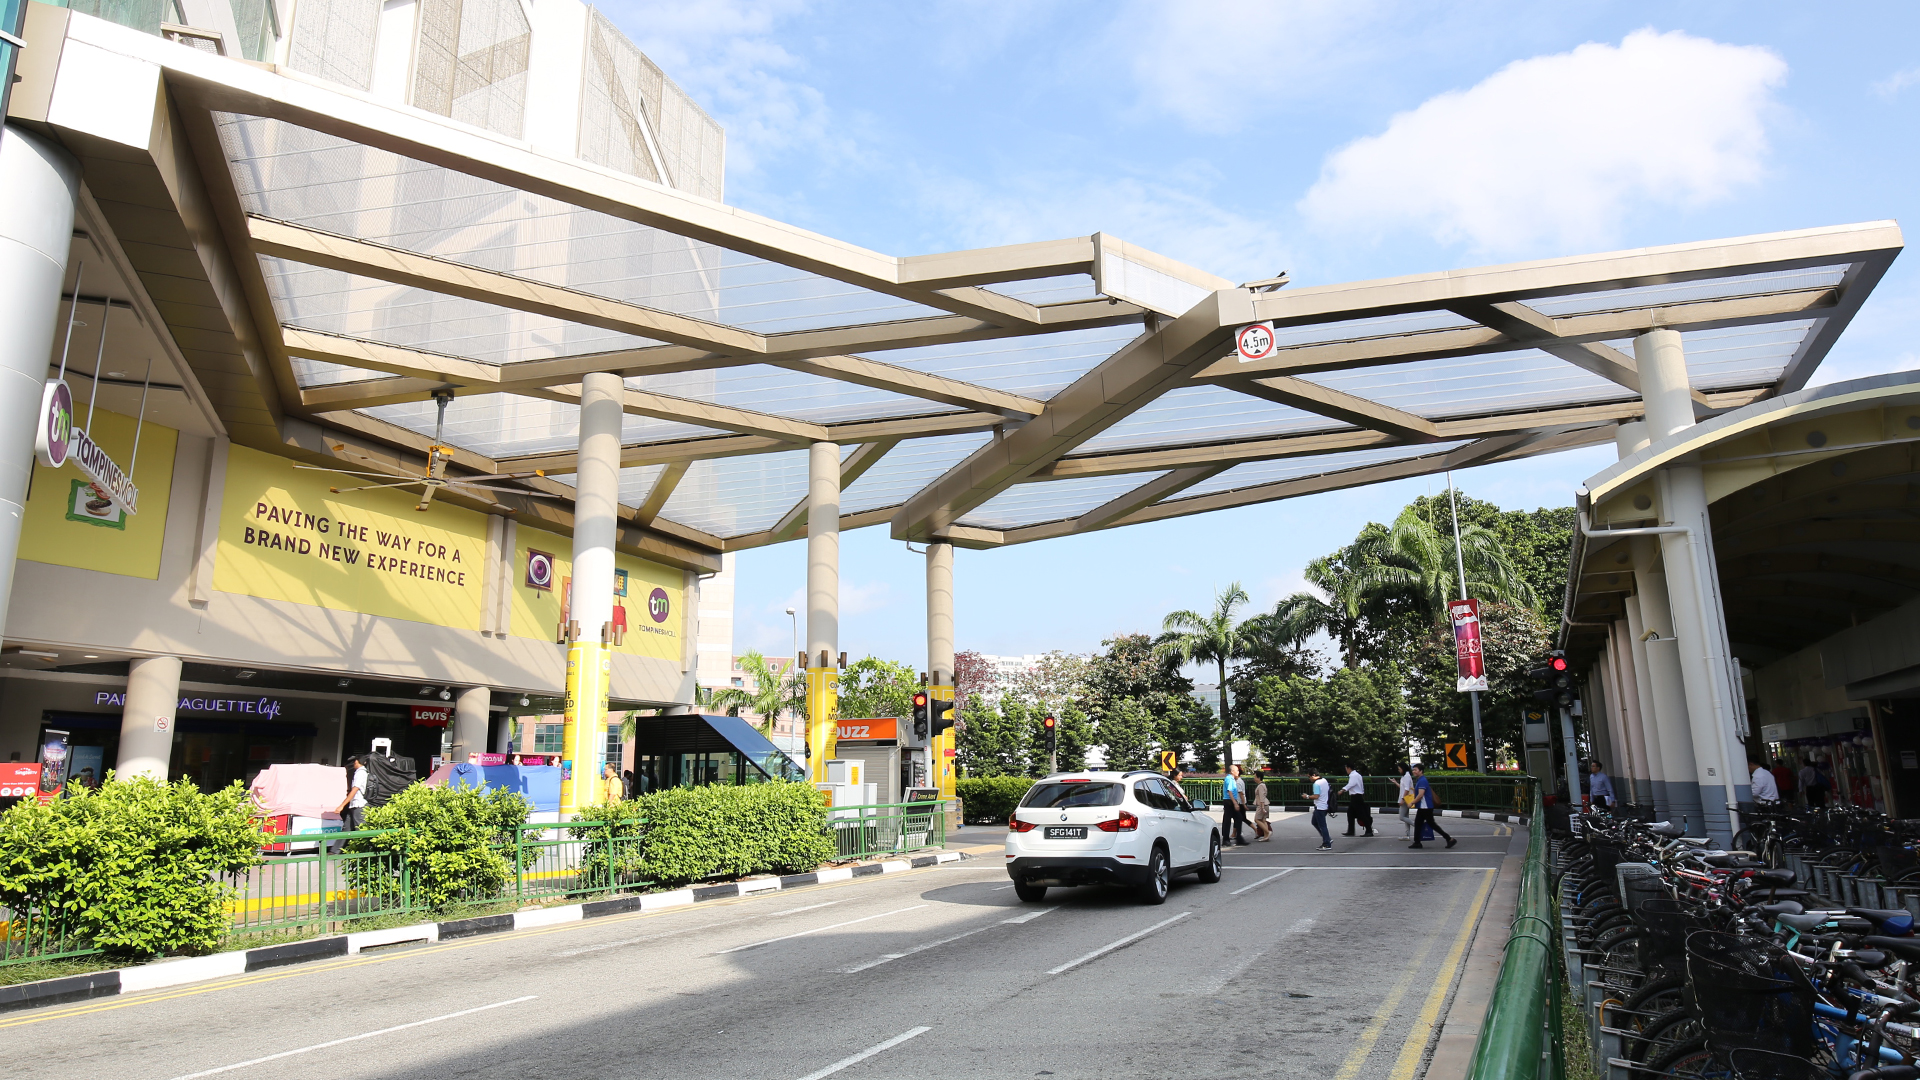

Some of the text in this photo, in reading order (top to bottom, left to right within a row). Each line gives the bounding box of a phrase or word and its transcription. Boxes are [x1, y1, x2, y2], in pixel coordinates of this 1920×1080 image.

[1243, 336, 1269, 349] 4.5m
[256, 502, 462, 564] PAVING THE WAY FOR A
[243, 526, 466, 587] BRAND NEW EXPERIENCE
[176, 697, 256, 713] AGUETTE
[256, 697, 281, 720] Café
[1049, 828, 1082, 836] SFG141T
